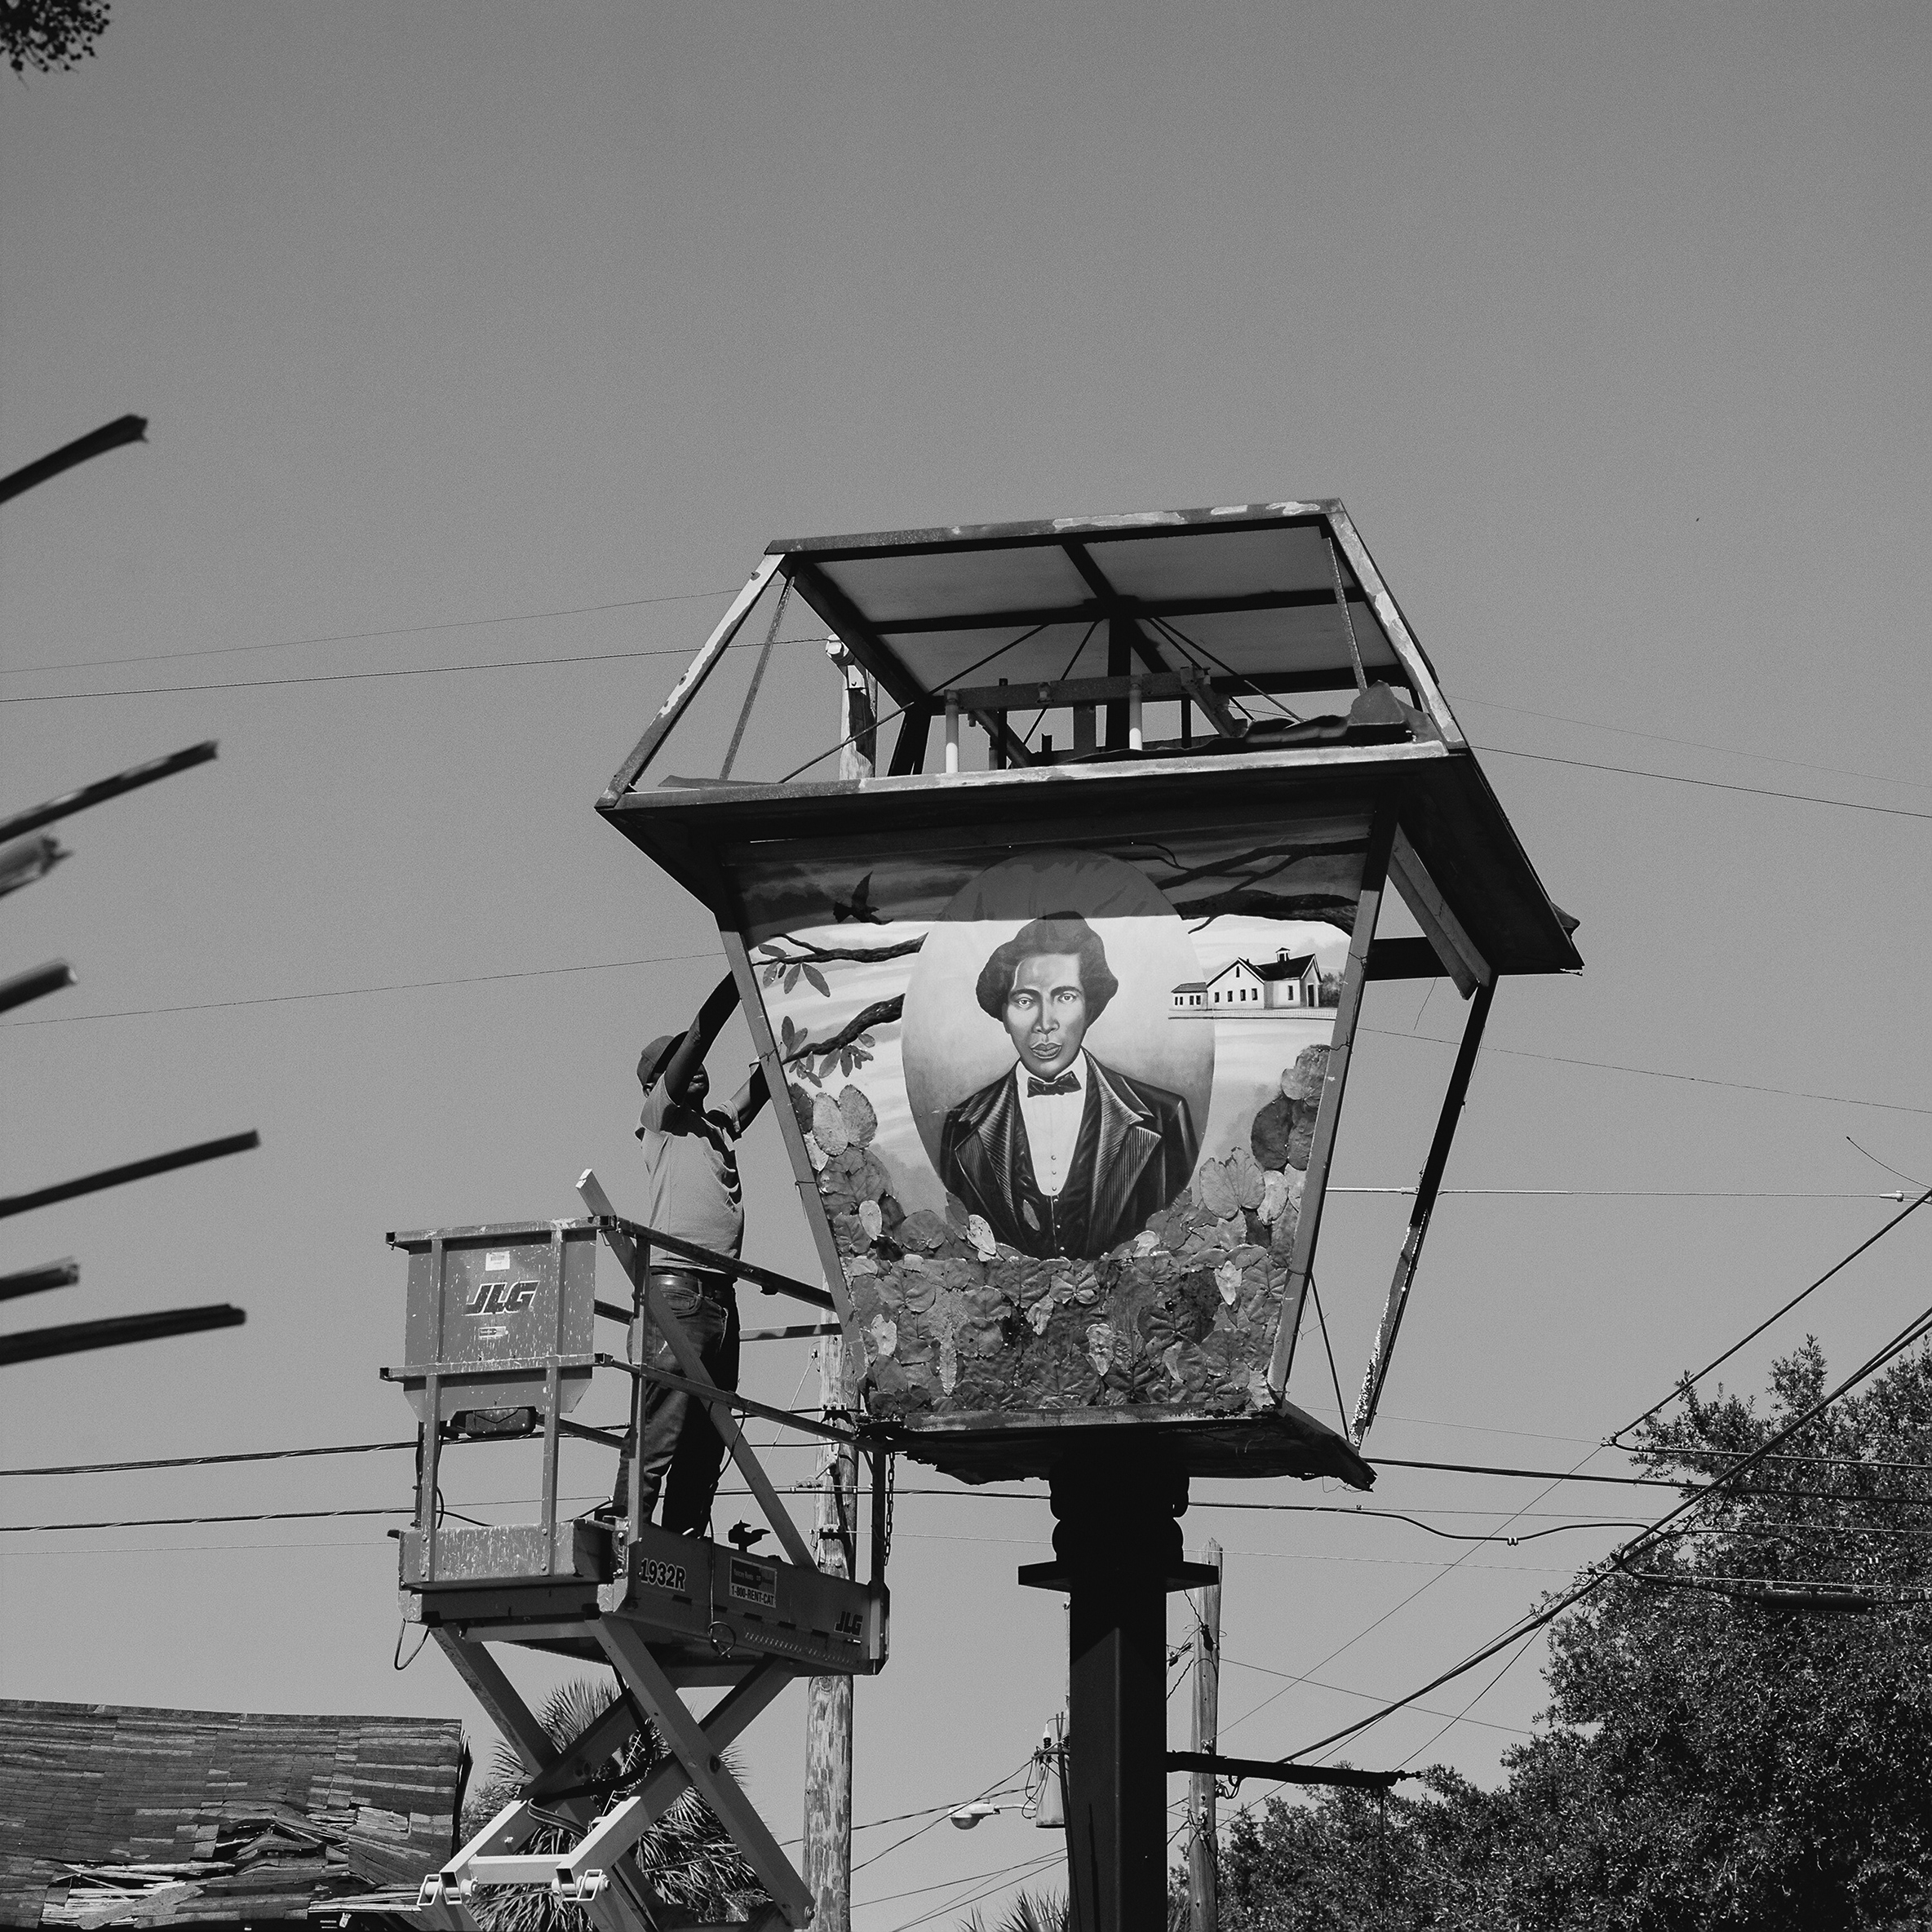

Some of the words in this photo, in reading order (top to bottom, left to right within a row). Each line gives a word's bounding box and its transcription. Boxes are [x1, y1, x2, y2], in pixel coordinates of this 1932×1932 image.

[463, 1280, 539, 1316] JLG
[640, 1557, 687, 1592] 1932R
[731, 1584, 774, 1606] 1-800-RENT-CAT
[834, 1611, 863, 1637] JLG
